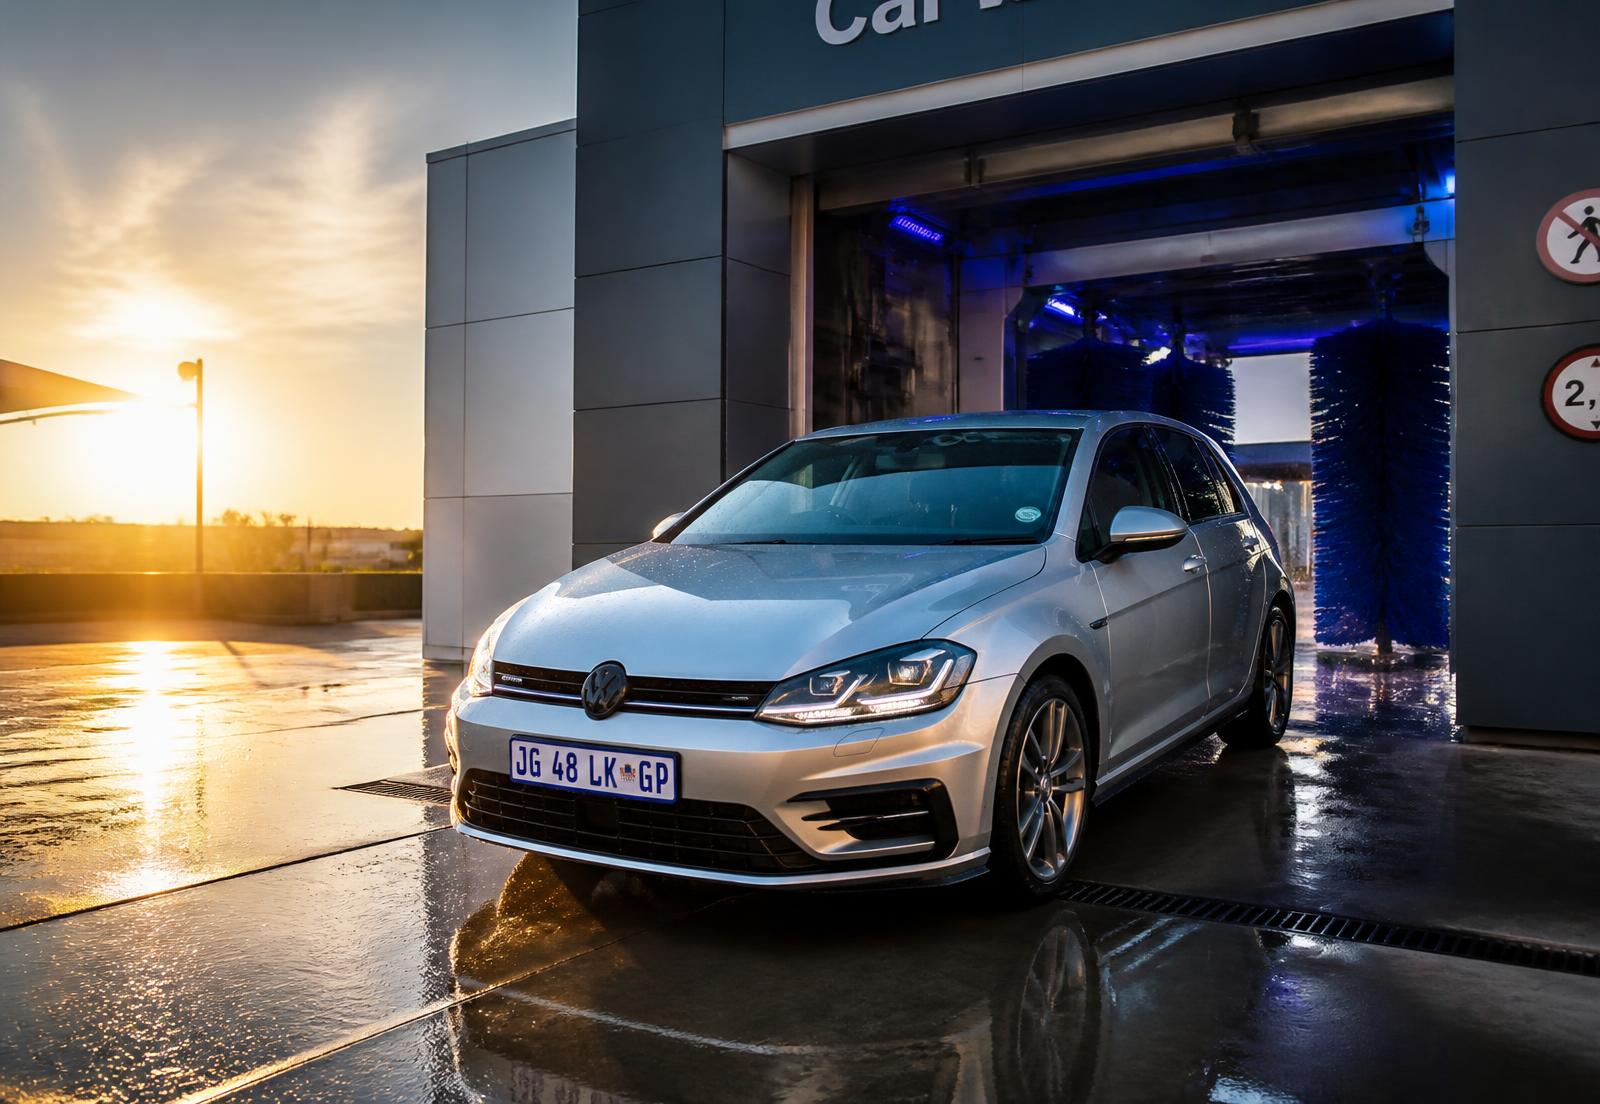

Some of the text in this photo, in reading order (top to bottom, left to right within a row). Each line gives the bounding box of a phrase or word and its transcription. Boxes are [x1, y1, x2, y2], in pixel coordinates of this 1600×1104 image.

[1565, 379, 1600, 410] 2,
[516, 746, 669, 794] JG 48 LK GP
